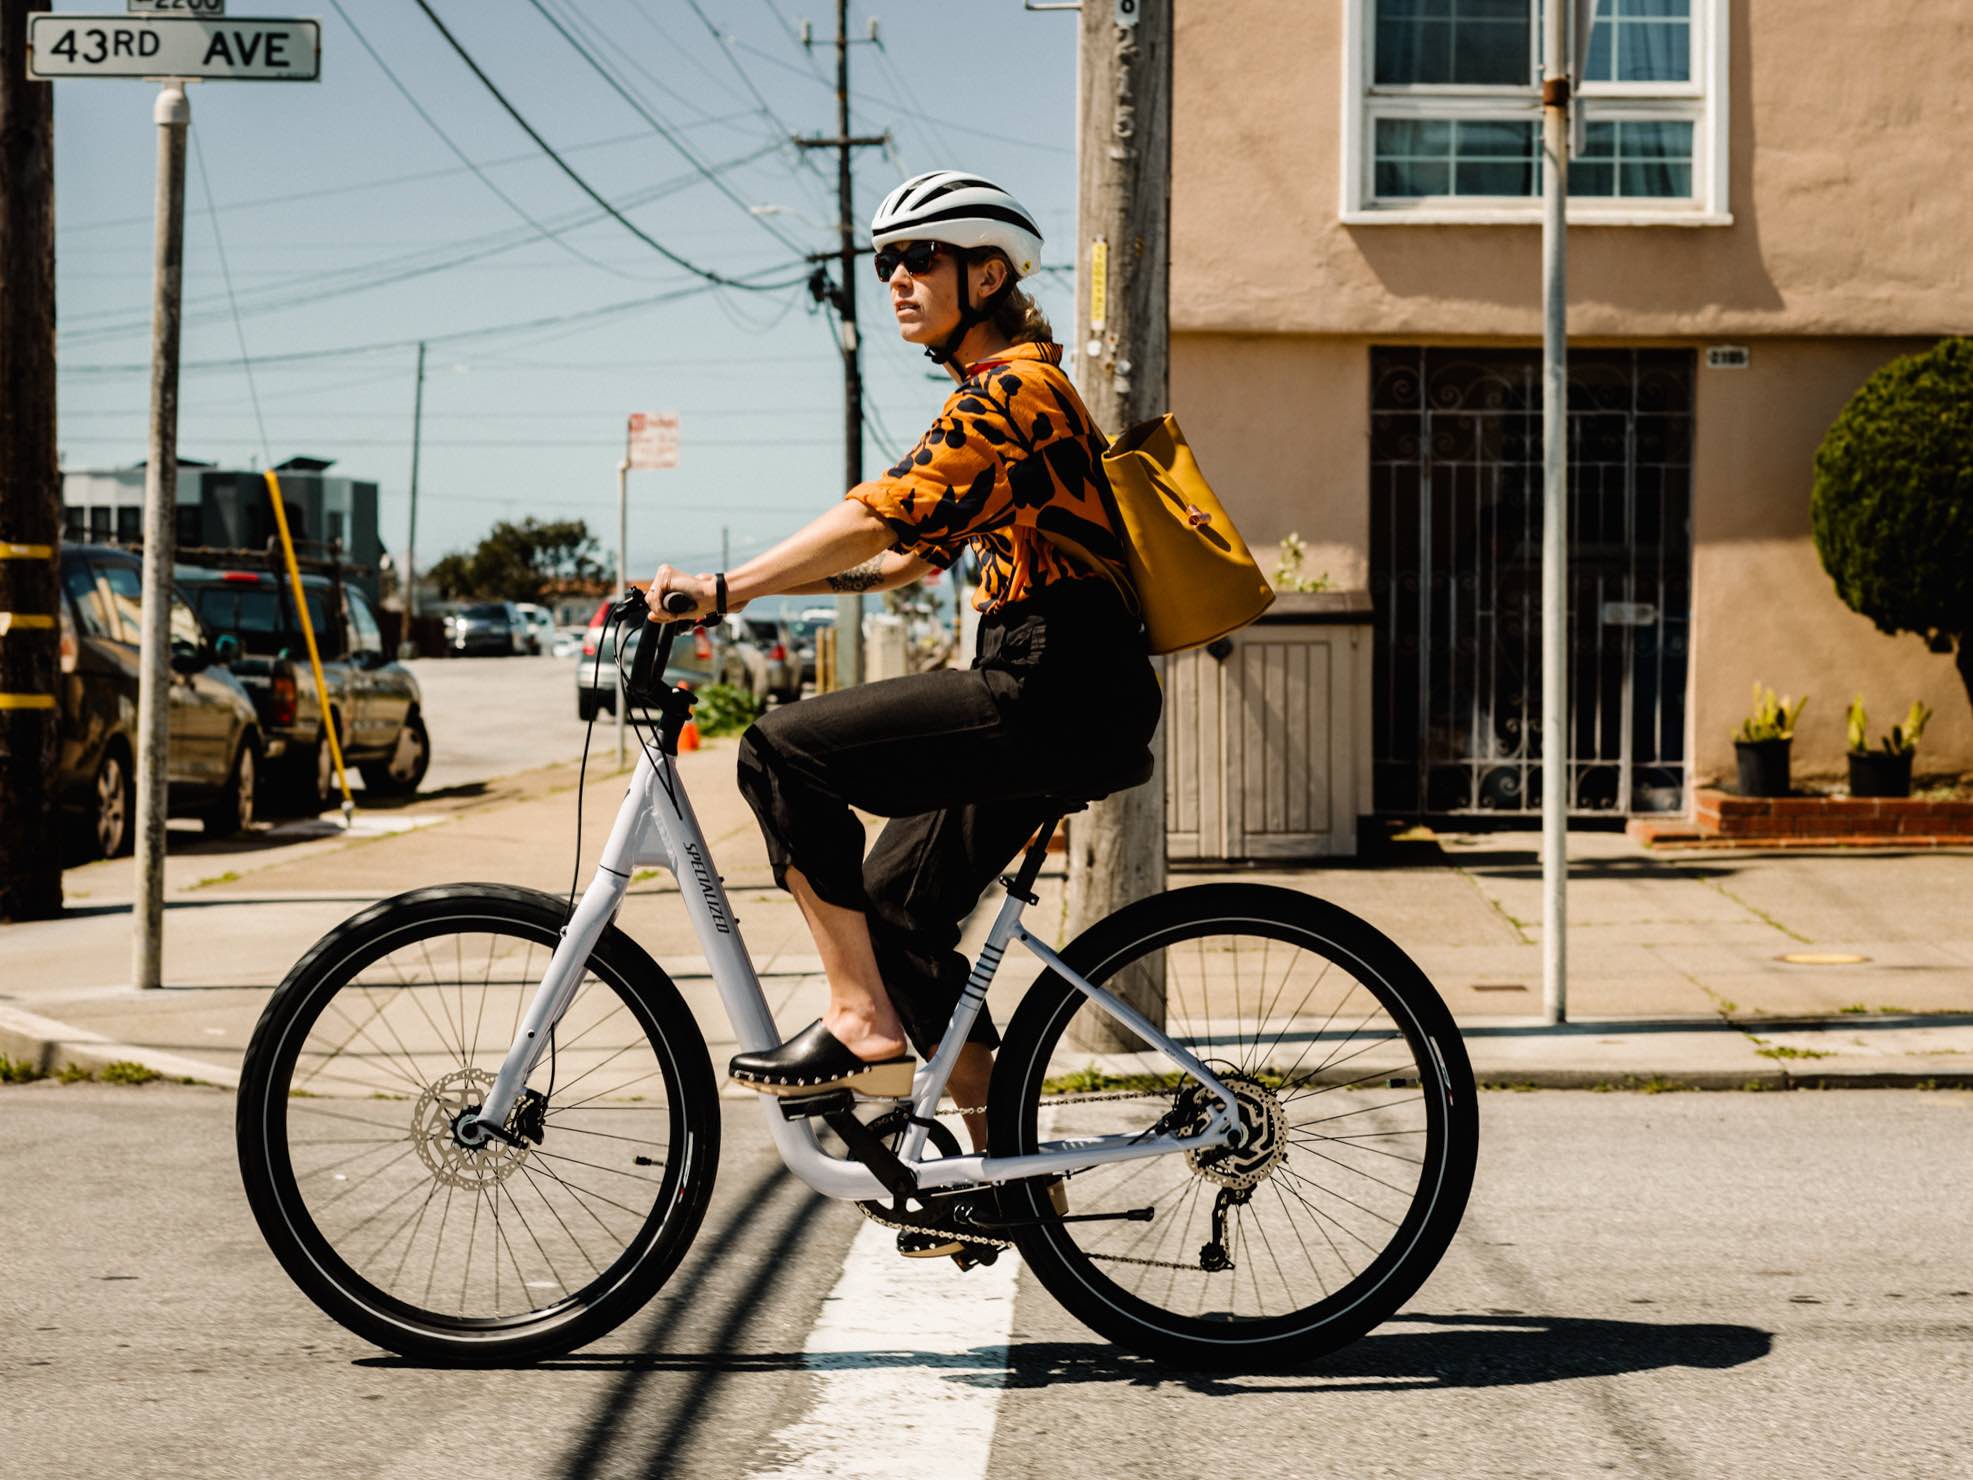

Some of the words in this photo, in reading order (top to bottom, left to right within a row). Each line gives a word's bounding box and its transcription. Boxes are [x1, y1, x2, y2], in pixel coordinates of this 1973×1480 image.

[50, 29, 161, 64] 43RD
[202, 31, 291, 67] AVE
[682, 841, 730, 934] SPECIALIZED
